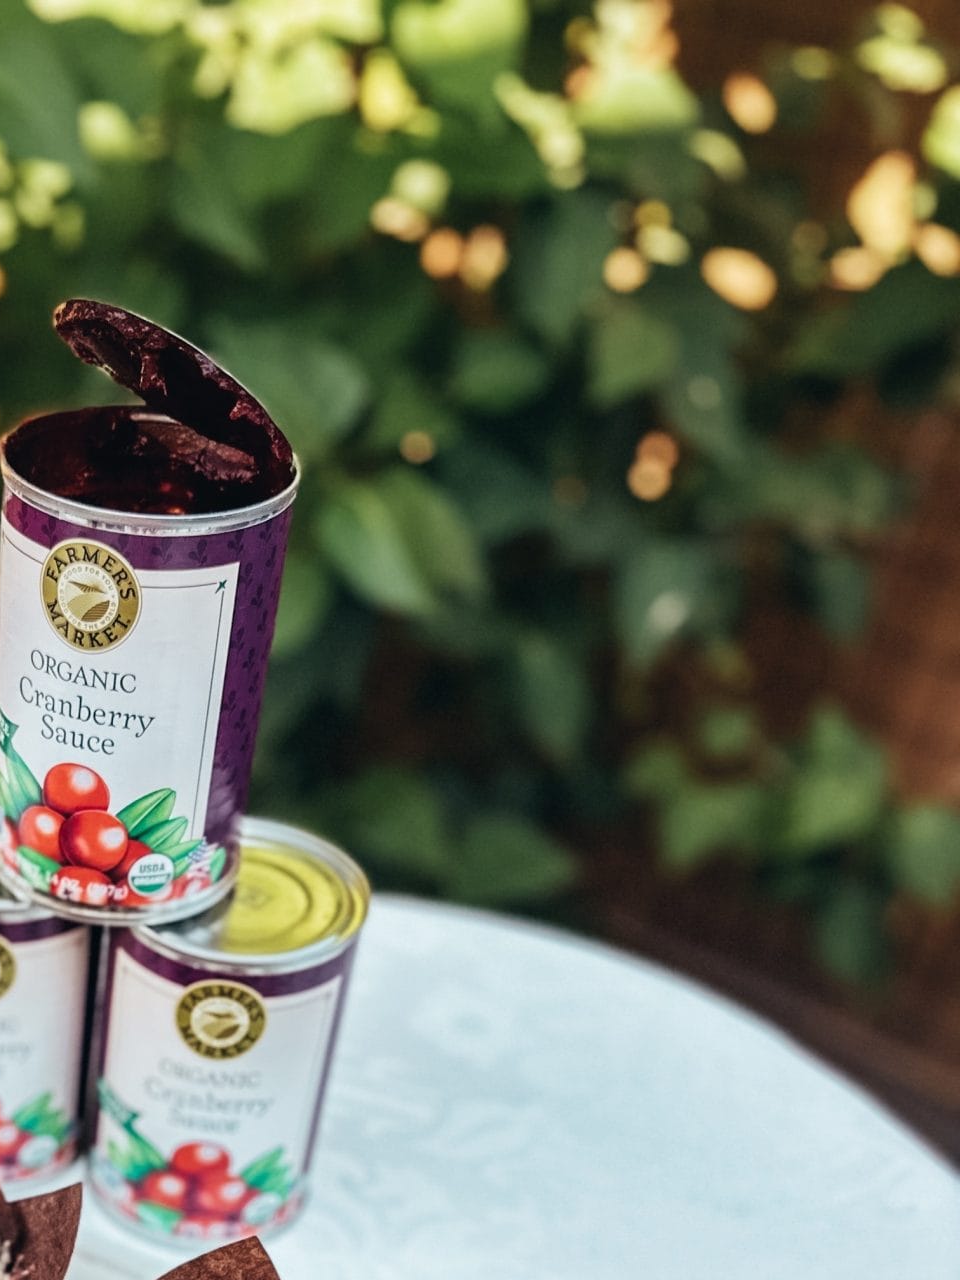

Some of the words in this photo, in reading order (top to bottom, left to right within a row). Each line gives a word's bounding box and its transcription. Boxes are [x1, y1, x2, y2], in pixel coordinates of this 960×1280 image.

[46, 546, 136, 600] FARMER'S
[46, 599, 129, 647] MARKET
[30, 649, 137, 694] ORGANIC
[19, 676, 156, 738] Cranberry
[41, 713, 115, 756] Sauce
[139, 863, 166, 874] USDA
